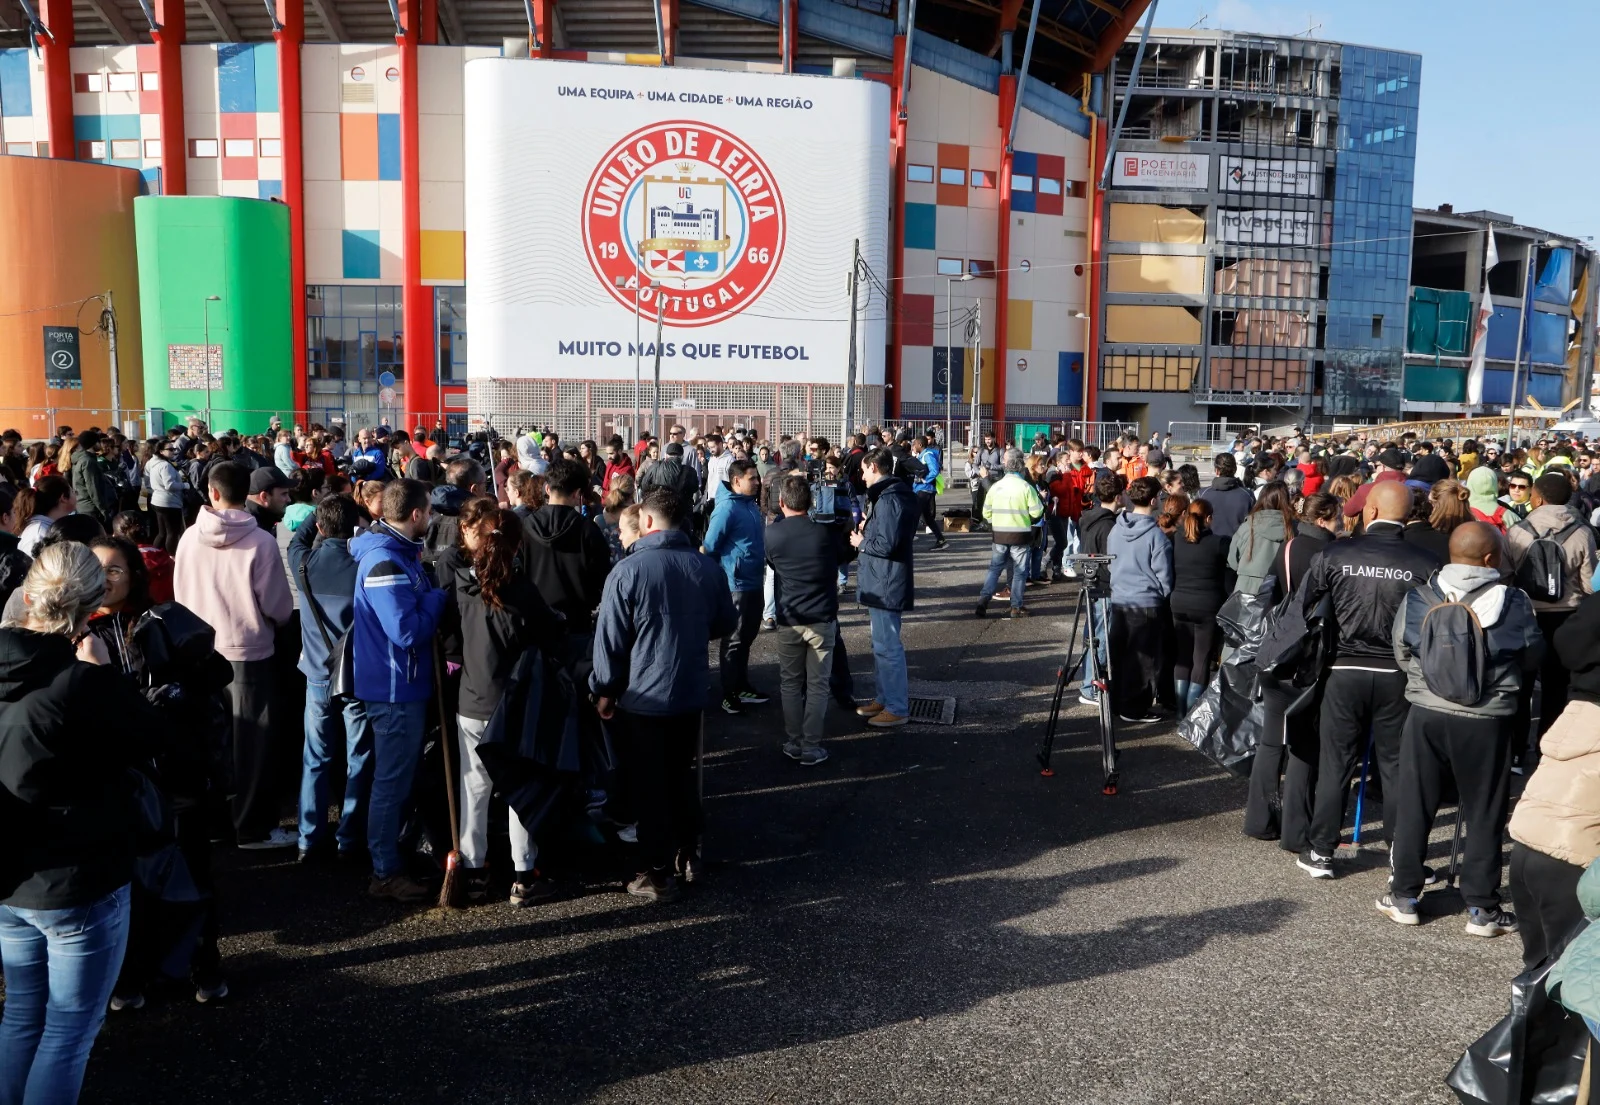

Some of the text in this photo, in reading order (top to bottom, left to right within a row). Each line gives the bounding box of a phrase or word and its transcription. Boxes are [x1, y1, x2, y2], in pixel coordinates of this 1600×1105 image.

[558, 86, 814, 110] UMA EQUIPA UMA CIDADE UMA REGIÃO
[1141, 158, 1197, 170] POÉTICA
[592, 130, 776, 222] UNIÃO DE LEIRIA
[598, 242, 619, 259] 19
[747, 247, 769, 264] 66
[624, 274, 745, 313] PORTUGAL
[48, 331, 74, 340] PORTA
[558, 340, 809, 361] MUITO MAIS QUE FUTEBOL
[58, 353, 68, 366] 2
[1342, 565, 1413, 582] FLAMENGO
